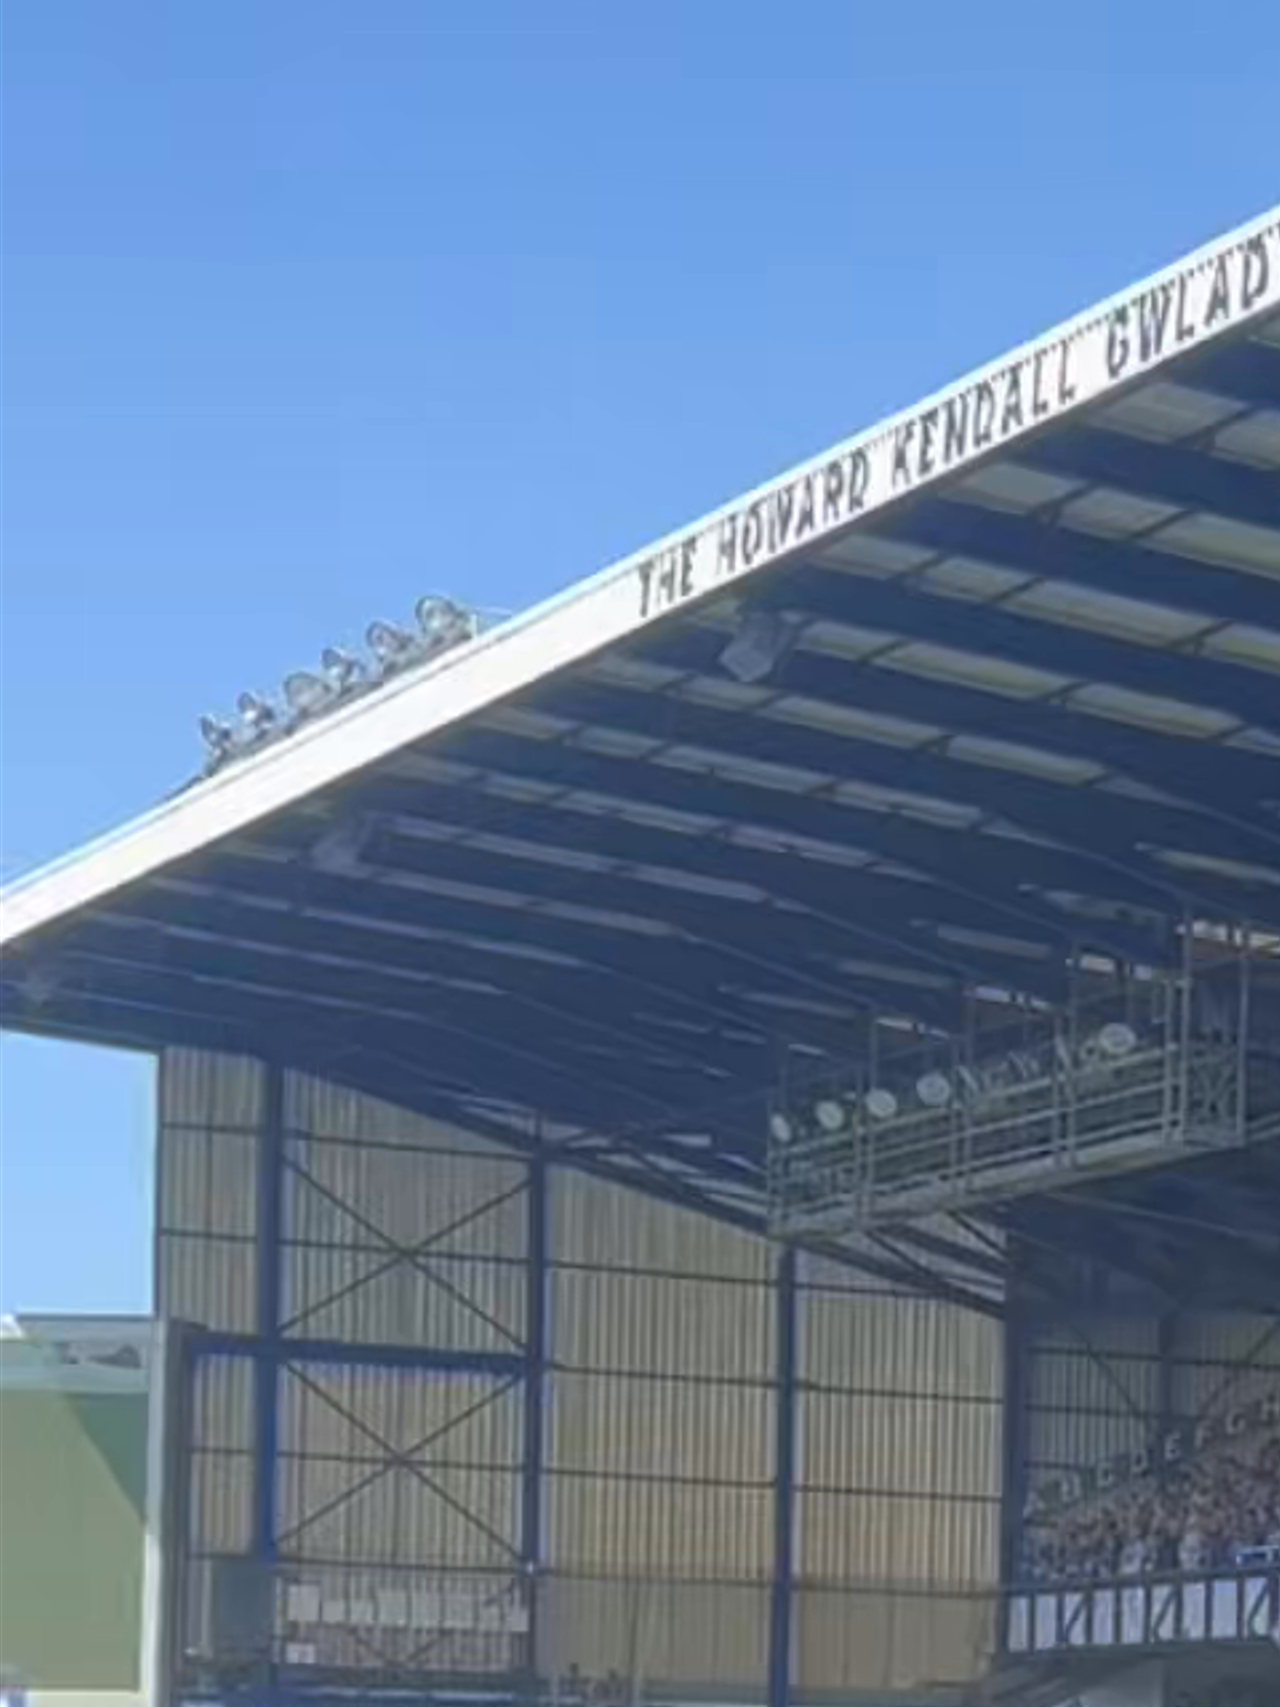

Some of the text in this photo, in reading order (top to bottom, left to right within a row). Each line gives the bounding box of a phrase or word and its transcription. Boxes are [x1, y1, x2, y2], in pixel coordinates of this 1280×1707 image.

[636, 536, 699, 618] THE
[715, 446, 870, 575] HOWARD
[890, 338, 1077, 492] KENDALL
